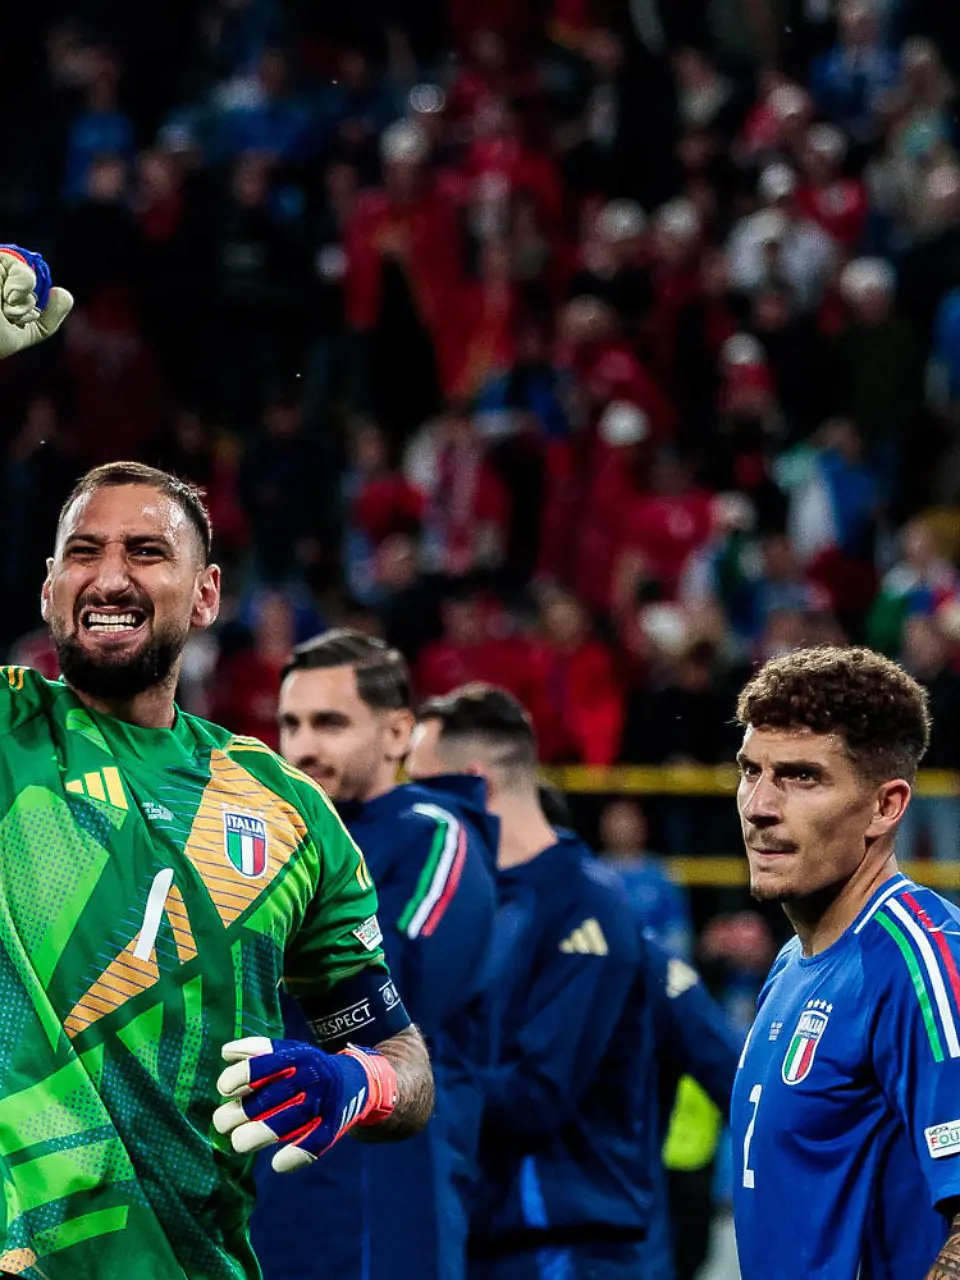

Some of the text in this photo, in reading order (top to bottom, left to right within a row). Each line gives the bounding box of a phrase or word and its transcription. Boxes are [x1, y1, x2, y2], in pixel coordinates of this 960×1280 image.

[227, 815, 265, 836] ITALIA
[133, 868, 174, 962] 1
[316, 1002, 371, 1036] RESPECT
[743, 1084, 762, 1188] 2
